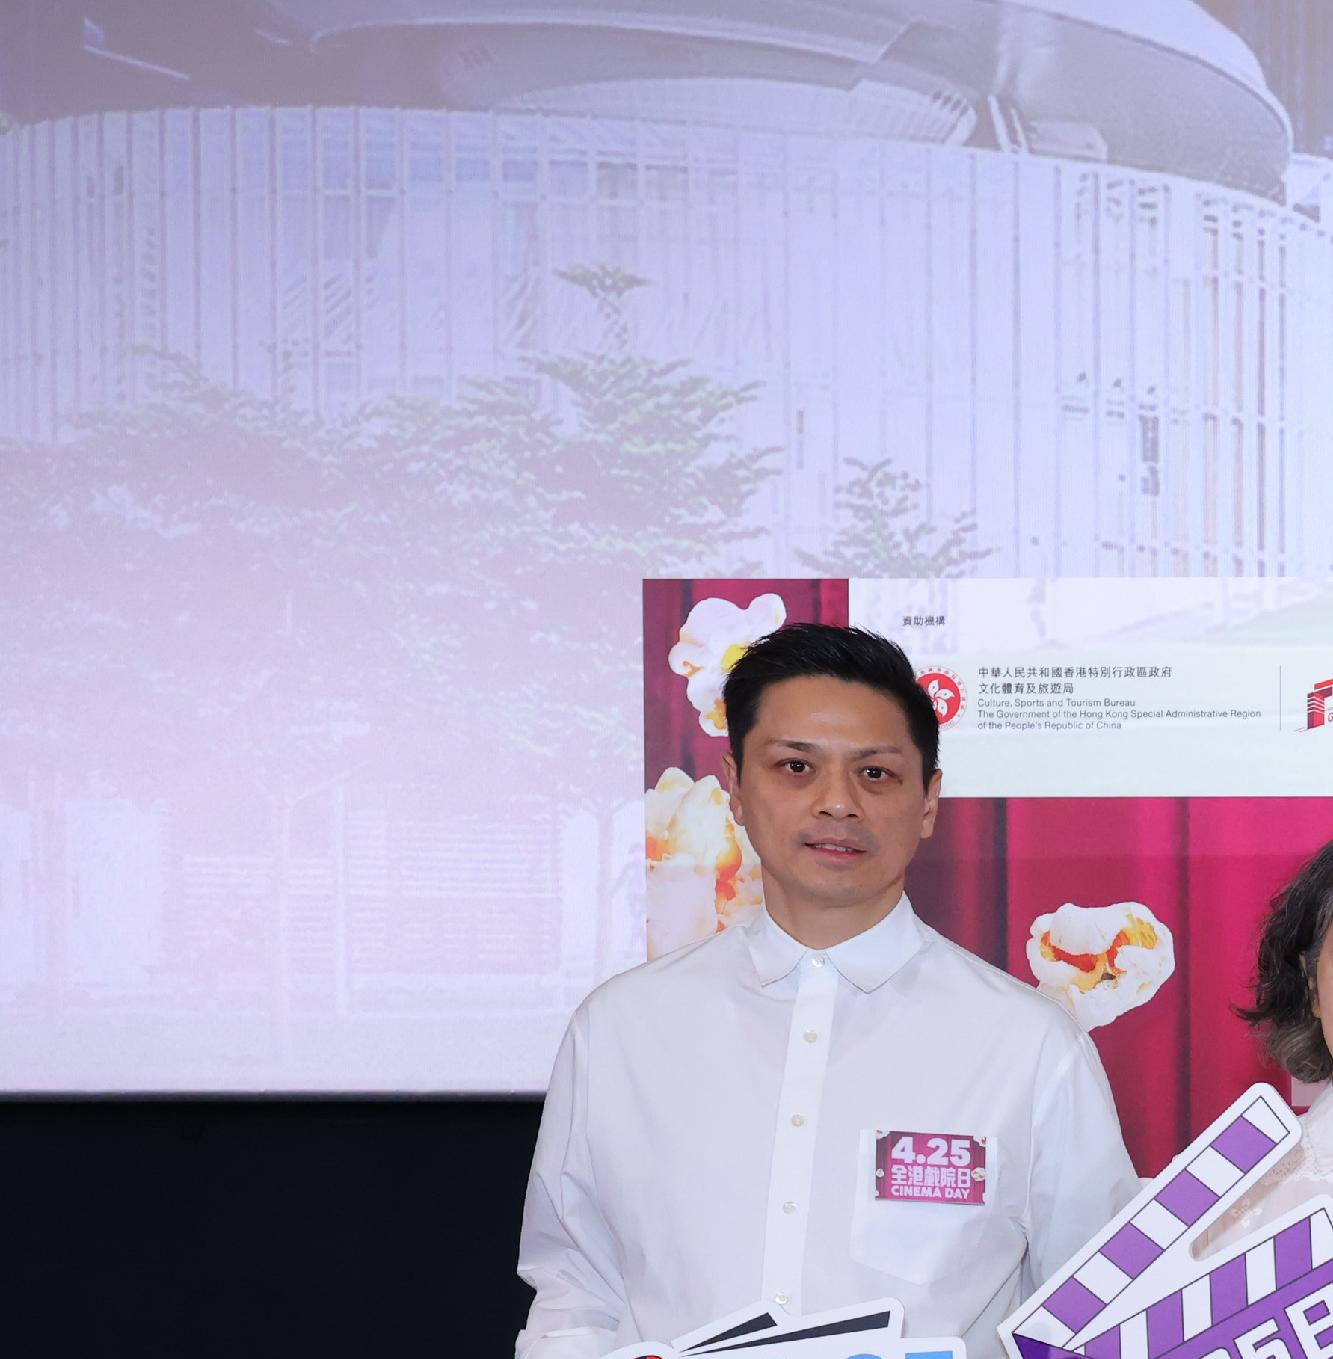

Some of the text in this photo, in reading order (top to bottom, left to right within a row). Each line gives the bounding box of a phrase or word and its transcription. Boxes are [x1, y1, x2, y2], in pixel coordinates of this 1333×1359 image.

[902, 616, 945, 626] 資助機構
[979, 666, 1172, 678] 中華人民共和國香港特別行政區政府
[979, 682, 1074, 694] 文化體育及旅遊局
[978, 698, 1136, 709] Culture, Sports and Tourism Bureau
[978, 710, 1261, 720] The Government of the Hong Kong Special Administrative Region
[978, 722, 1122, 731] of the People's Republic of China
[891, 1136, 970, 1166] 4.25
[891, 1164, 971, 1188] 全港戲院日
[891, 1185, 970, 1199] CINEMA DAY
